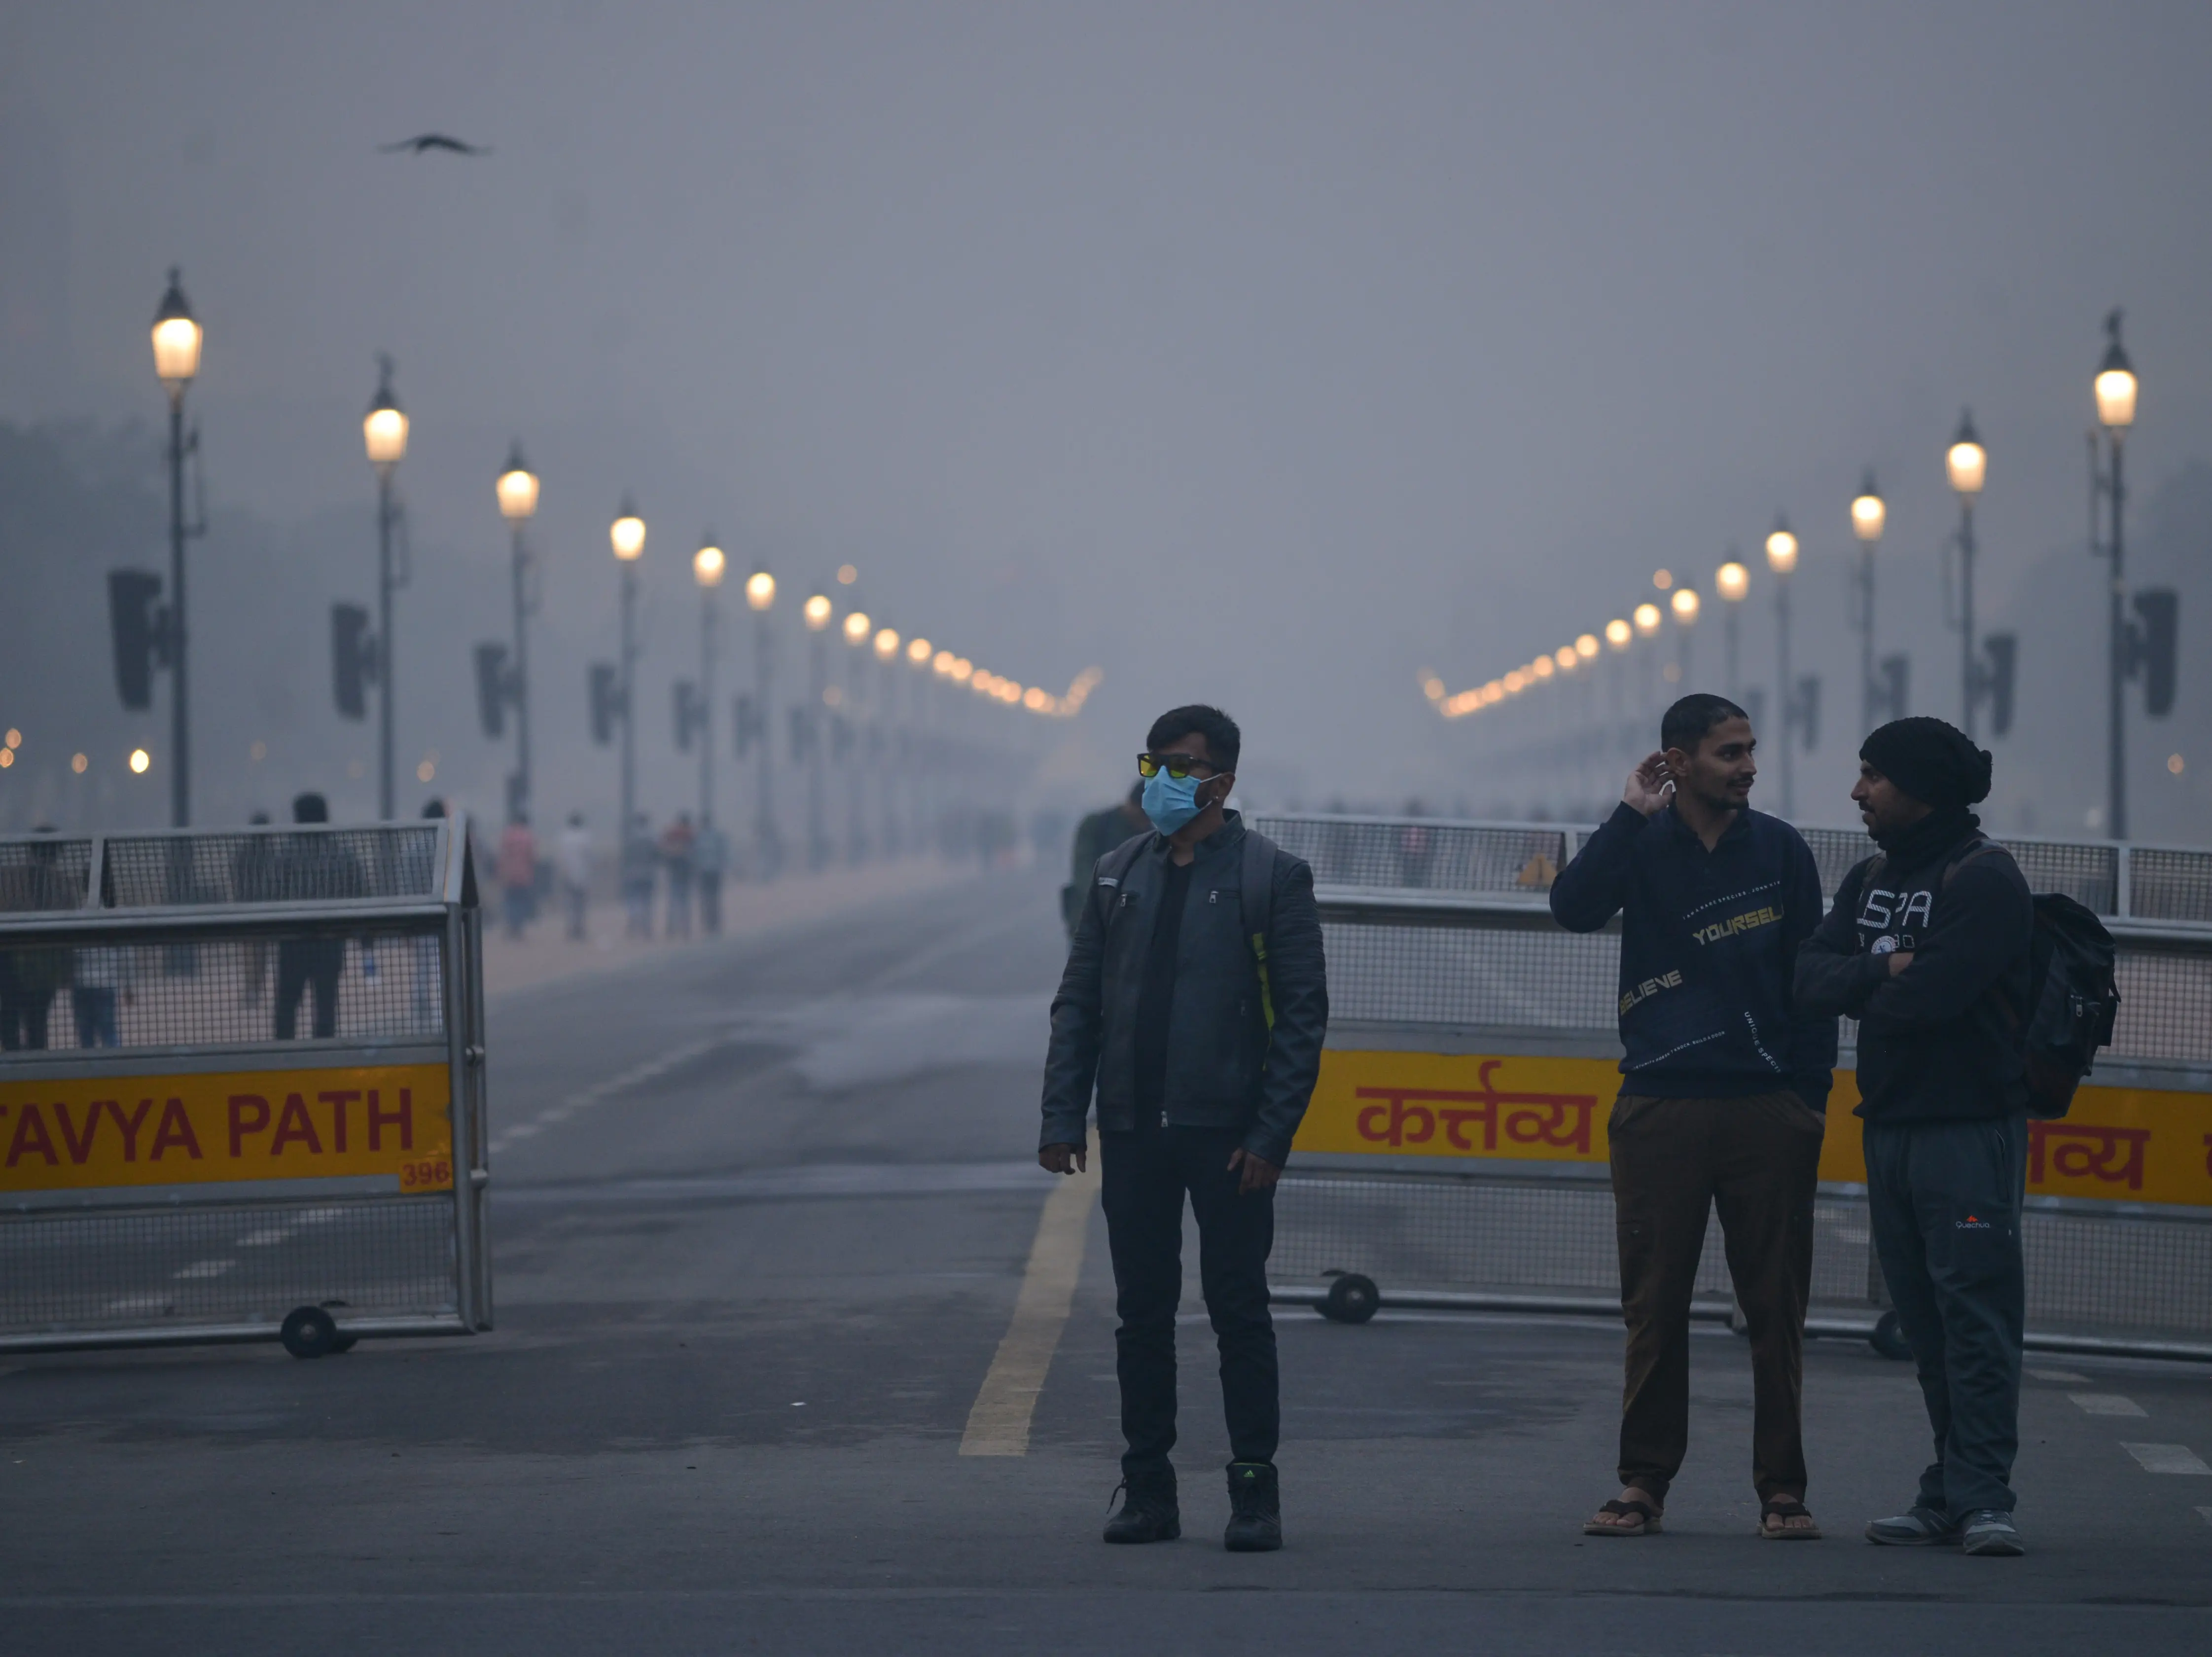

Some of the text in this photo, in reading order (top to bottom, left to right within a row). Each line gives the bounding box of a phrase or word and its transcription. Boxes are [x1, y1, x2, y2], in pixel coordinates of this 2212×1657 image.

[1619, 969, 1683, 1016] BELIEVE
[1744, 1011, 1761, 1046] UNIQUE
[0, 1088, 413, 1168] AVYA PATH
[402, 1161, 450, 1186] 396
[1956, 1221, 1990, 1229] Quechua
